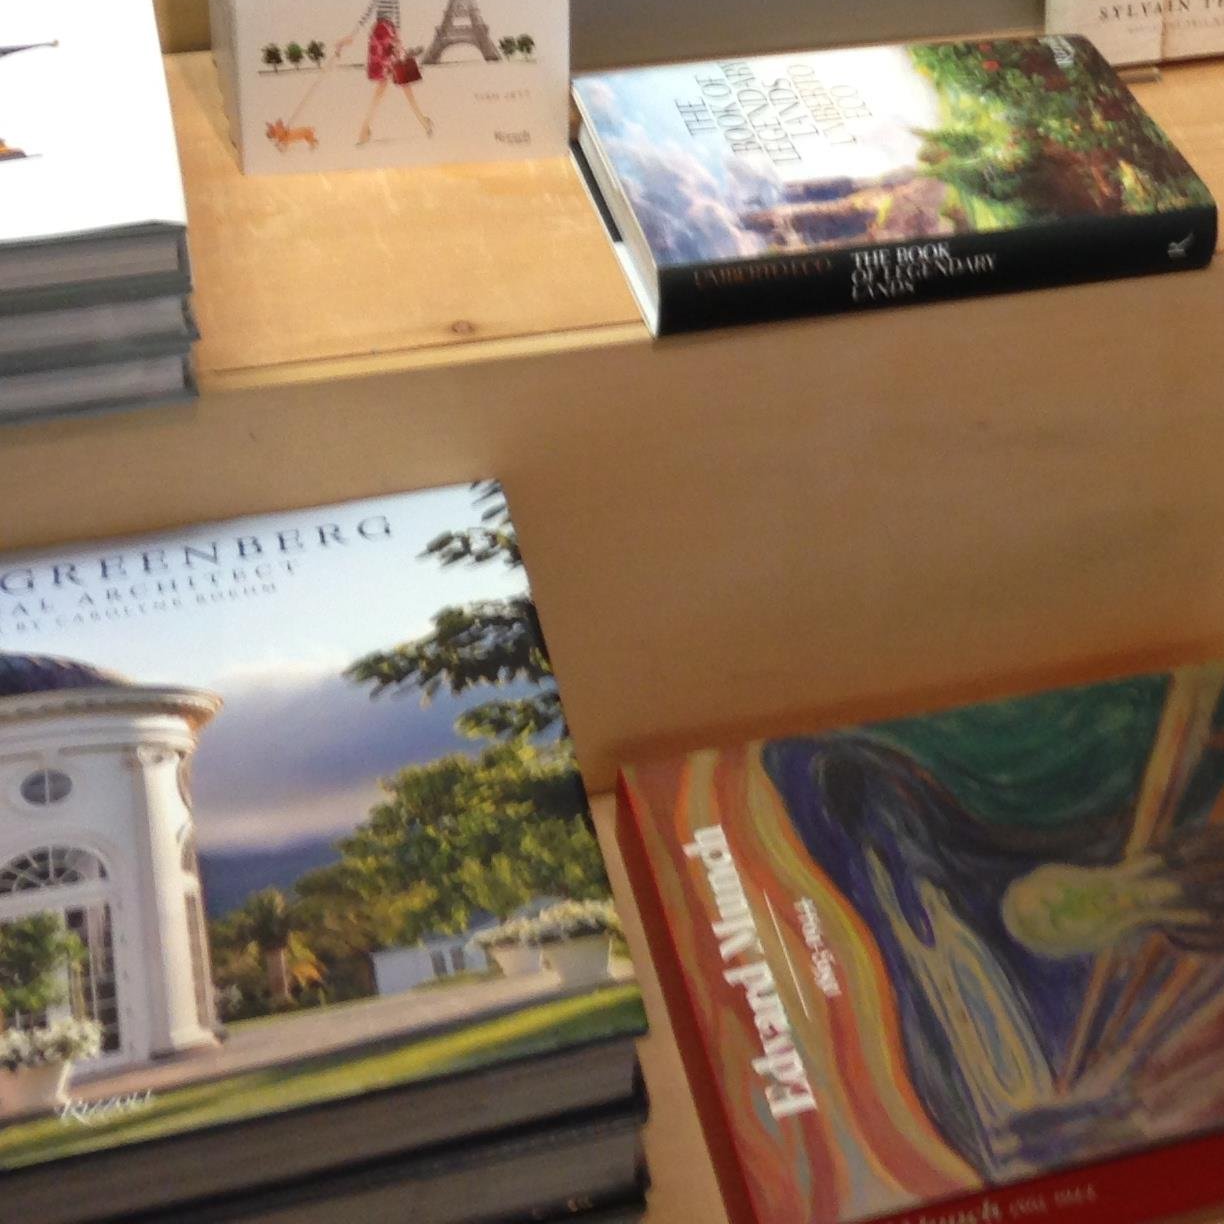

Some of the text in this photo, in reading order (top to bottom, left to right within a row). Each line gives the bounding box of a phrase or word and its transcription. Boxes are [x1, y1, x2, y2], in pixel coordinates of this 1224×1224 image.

[674, 96, 718, 137] THE
[852, 241, 951, 270] THE BOOK
[0, 515, 394, 596] GREENBERG
[78, 558, 301, 608] ARCHITECT
[683, 824, 818, 1122] Edvard Munch
